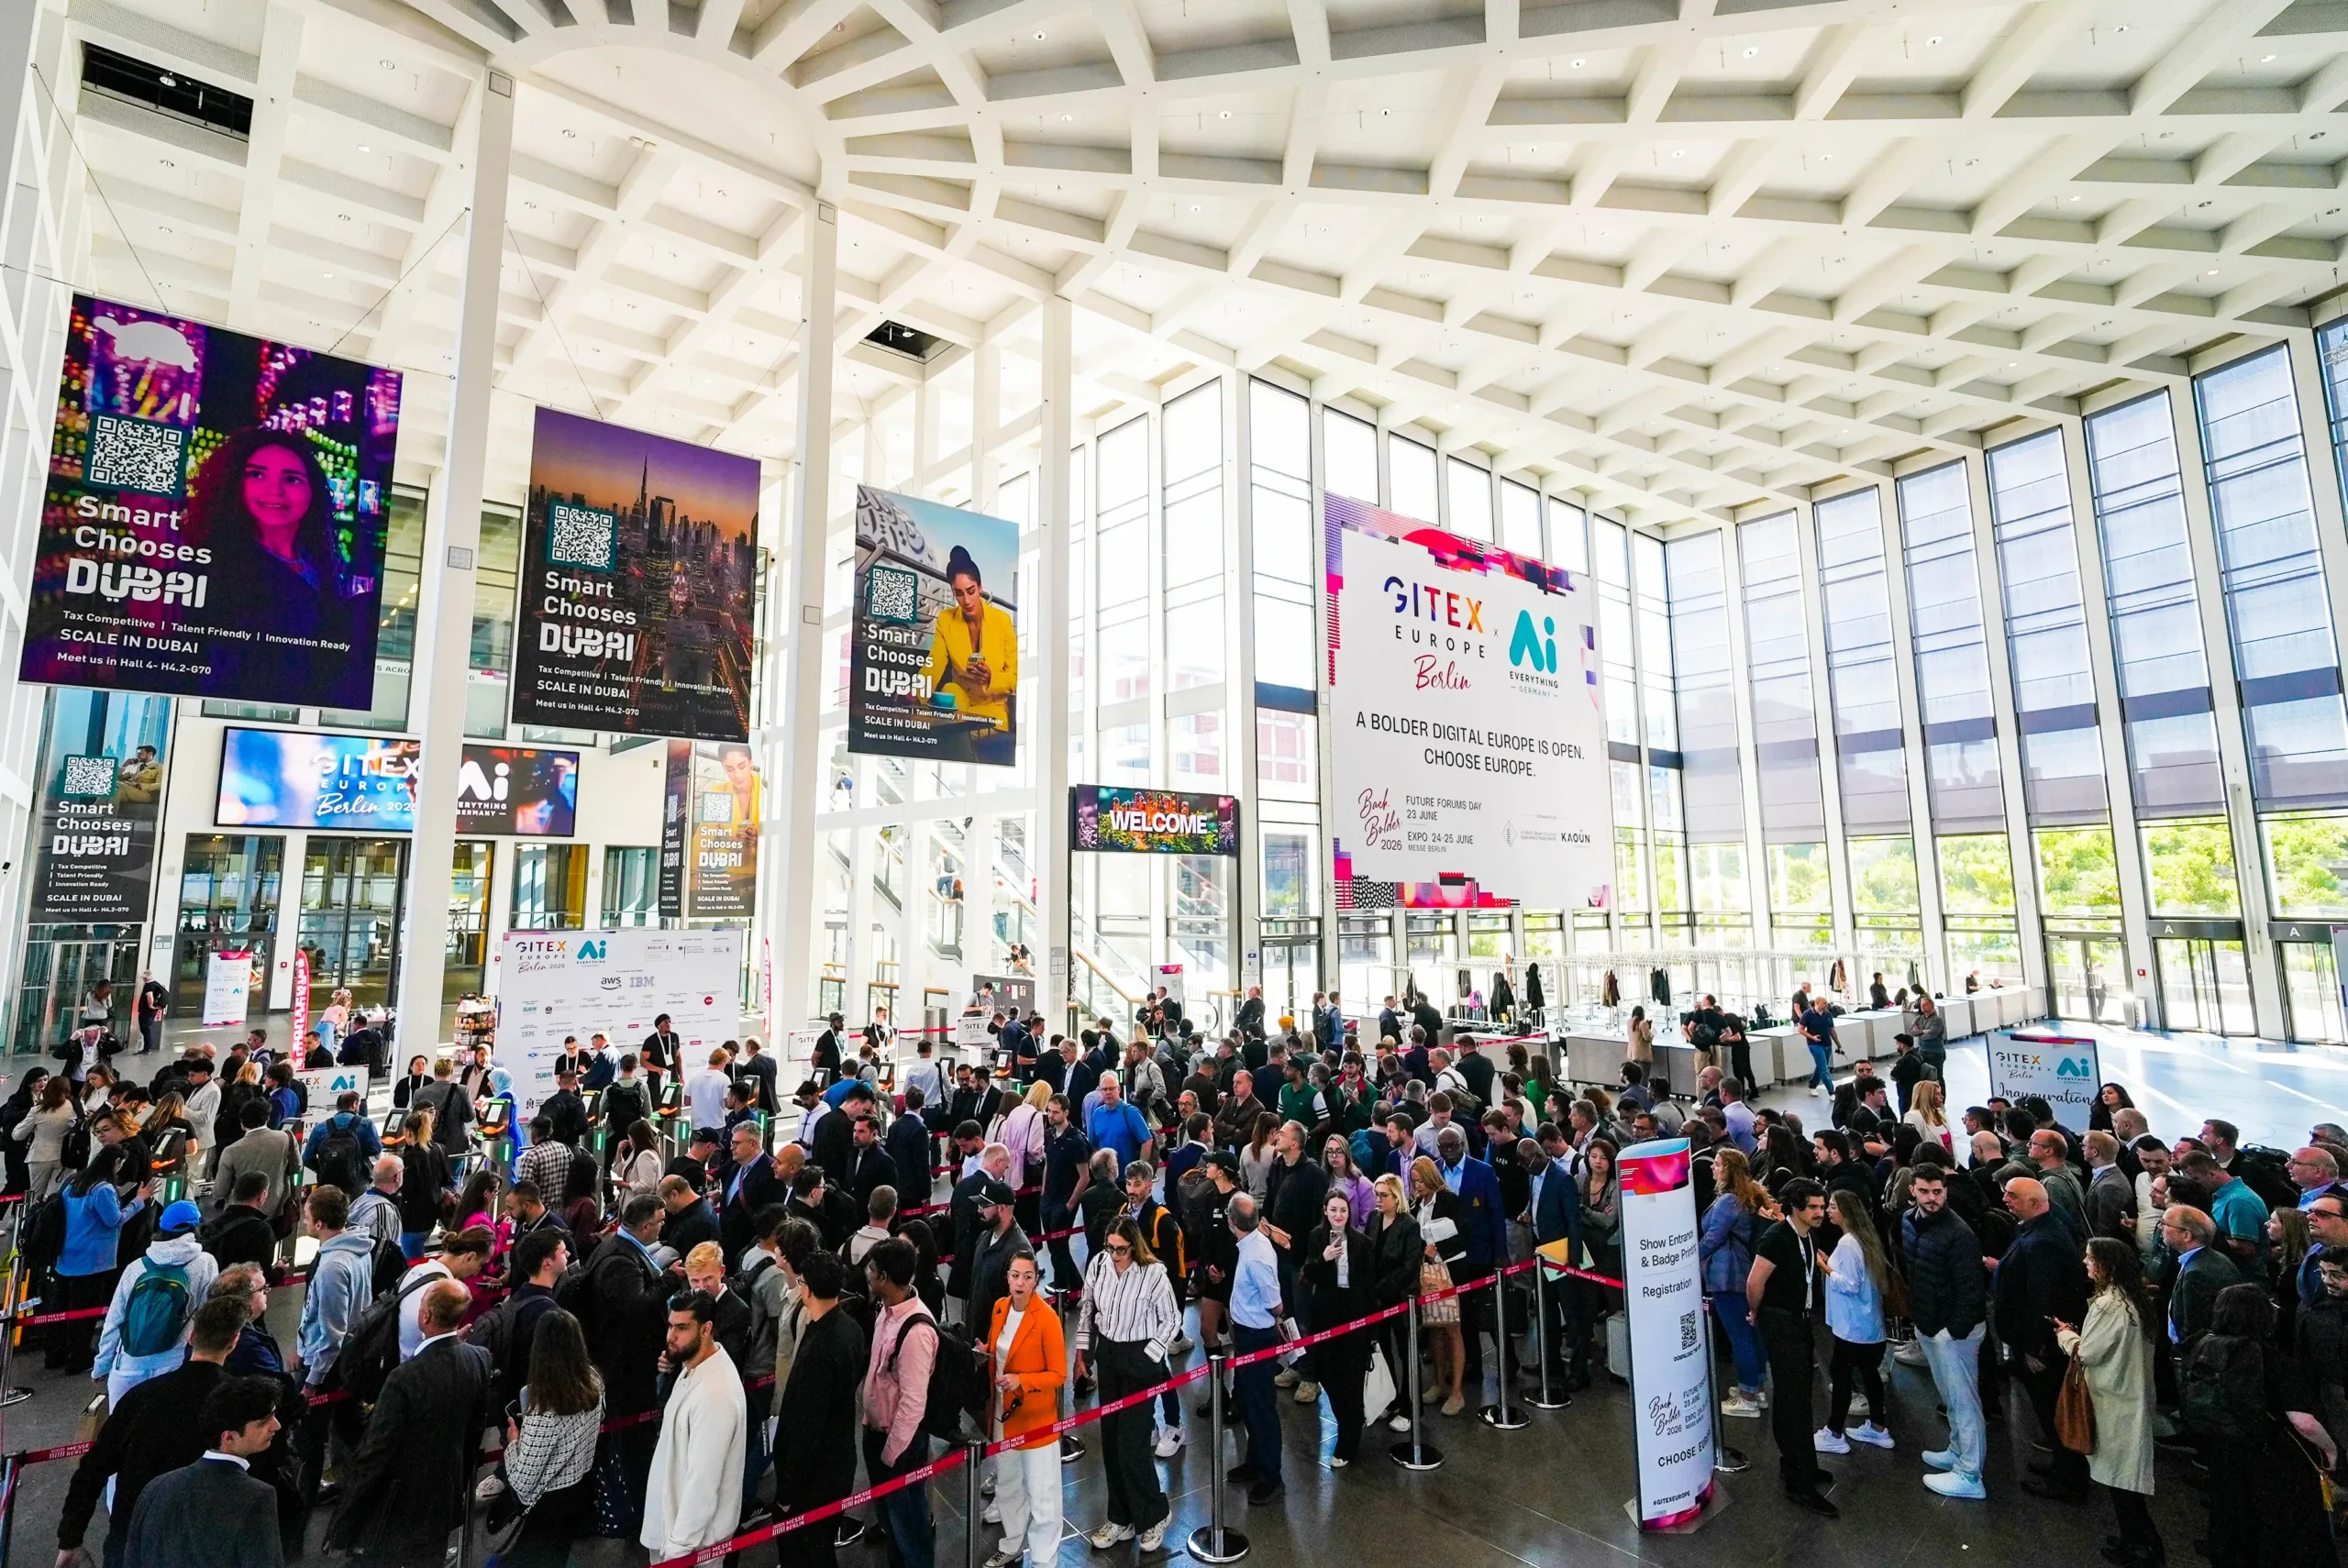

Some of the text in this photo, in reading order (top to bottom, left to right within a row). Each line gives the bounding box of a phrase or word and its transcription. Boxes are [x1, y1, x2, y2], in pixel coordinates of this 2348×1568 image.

[77, 495, 183, 531] Smart
[75, 525, 212, 564] Chooses
[65, 558, 208, 608] DUBAI
[545, 570, 614, 598] Smart
[544, 595, 637, 625] Chooses
[1384, 576, 1484, 634] GITEX
[62, 610, 351, 652] Tax Competitive Talent Friendly Innovation Ready
[868, 624, 917, 646] Smart
[60, 628, 198, 654] SCALE IN DUBAI
[539, 622, 635, 661] DUBAI
[1395, 624, 1485, 658] EUROPE
[1509, 609, 1557, 674] Ai
[57, 652, 212, 675] Meet us in Hall 4- H4.2-G70
[867, 645, 934, 668] Chooses
[537, 665, 733, 695] Tax Competitive Talent Friendly Innovation Ready
[1414, 654, 1472, 690] Berlin
[1510, 671, 1558, 689] EVERYTHING
[537, 679, 630, 699] SCALE IN DUBAI
[865, 667, 933, 699] DUBAI
[1519, 686, 1551, 699] GERMANY
[536, 699, 556, 708] Meet
[569, 701, 576, 710] in
[578, 703, 593, 712] Hall
[876, 704, 909, 714] Competitive
[916, 709, 933, 717] Talent
[934, 711, 956, 721] Friendly
[961, 714, 988, 723] Innovation
[864, 715, 930, 730] SCALE IN DUBAI
[1356, 711, 1585, 760] A BOLDER DIGITAL EUROPE IS OPEN.
[311, 754, 420, 778] GITEX
[1424, 748, 1536, 777] CHOOSE EUROPE.
[321, 780, 418, 793] EUROP
[58, 801, 115, 815] Smart
[316, 792, 382, 816] Berlin
[1358, 788, 1390, 819] Back
[1406, 795, 1482, 812] FUTURE FORUMS DAY
[1109, 810, 1208, 834] WELCOME
[1406, 809, 1438, 821] 23 JUNE
[56, 817, 131, 832] Chooses
[700, 826, 733, 837] Smart
[1364, 810, 1401, 846] Bolder
[51, 834, 129, 857] DUBAI
[700, 839, 743, 849] Chooses
[1380, 839, 1402, 851] 2026
[1407, 832, 1474, 845] EXPO 24-25 JUNE
[1408, 844, 1446, 853] MESSE BERLIN
[698, 852, 742, 869] DUBAI
[2164, 924, 2175, 934] A
[2288, 926, 2300, 937] A
[515, 941, 567, 953] GITEX
[577, 940, 607, 960] Ai
[517, 961, 548, 974] Berlin
[629, 976, 655, 988] IBM
[1995, 1051, 2041, 1065] GITEX
[2000, 1063, 2042, 1071] EUROPE
[2009, 1069, 2034, 1079] Berlin
[2056, 1057, 2089, 1077] Ai
[331, 1075, 356, 1091] Ai
[1640, 1229, 1694, 1251] Show Entrance
[1641, 1253, 1679, 1268] & Badge
[1643, 1278, 1692, 1298] Registration
[1674, 1350, 1693, 1362] DOWNLOAD
[1649, 1392, 1672, 1419] Back
[1684, 1400, 1690, 1408] 23
[1654, 1406, 1681, 1436] Bolder
[1685, 1411, 1696, 1423] EXPO
[1667, 1425, 1682, 1436] 2026
[66, 1442, 90, 1451] MESSE
[66, 1448, 90, 1457] BERLIN
[1658, 1446, 1696, 1467] CHOOSE
[917, 1464, 933, 1474] MESSE
[917, 1470, 934, 1480] BERLIN
[853, 1495, 871, 1506] BERLIN
[854, 1489, 871, 1499] MESSE
[1653, 1490, 1690, 1506] #GITEXEUROPE
[785, 1514, 805, 1525] MESSE
[785, 1520, 805, 1531] BERLIN
[712, 1540, 733, 1551] MESSE
[712, 1547, 733, 1558] BERLIN
